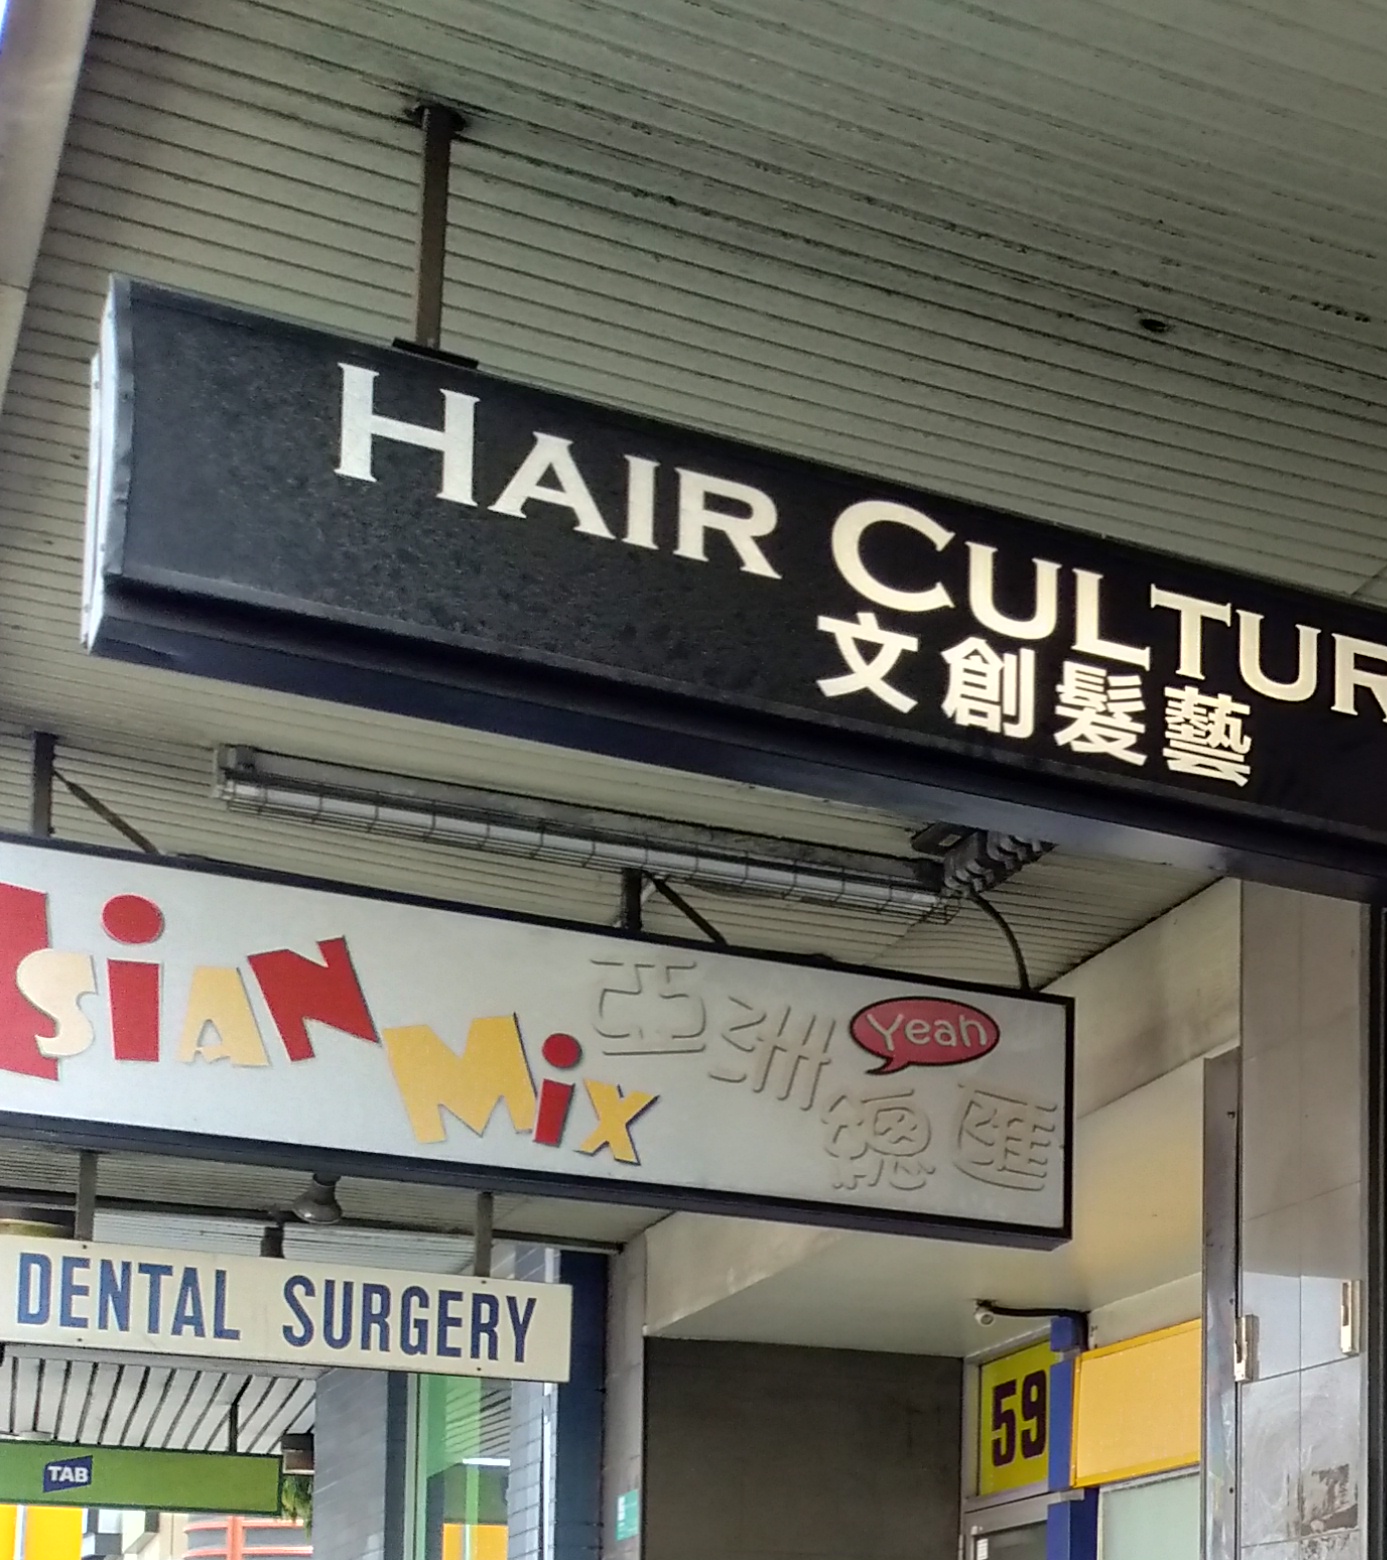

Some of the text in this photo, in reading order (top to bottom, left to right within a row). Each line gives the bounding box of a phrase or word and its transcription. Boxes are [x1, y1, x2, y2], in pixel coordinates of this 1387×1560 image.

[334, 363, 782, 580] HAIR
[815, 613, 1252, 787] 文創髮藝
[865, 1012, 988, 1053] Yeah
[16, 1251, 538, 1363] DENTAL SURGERY
[991, 1369, 1047, 1468] 59
[48, 1465, 90, 1484] TAB
